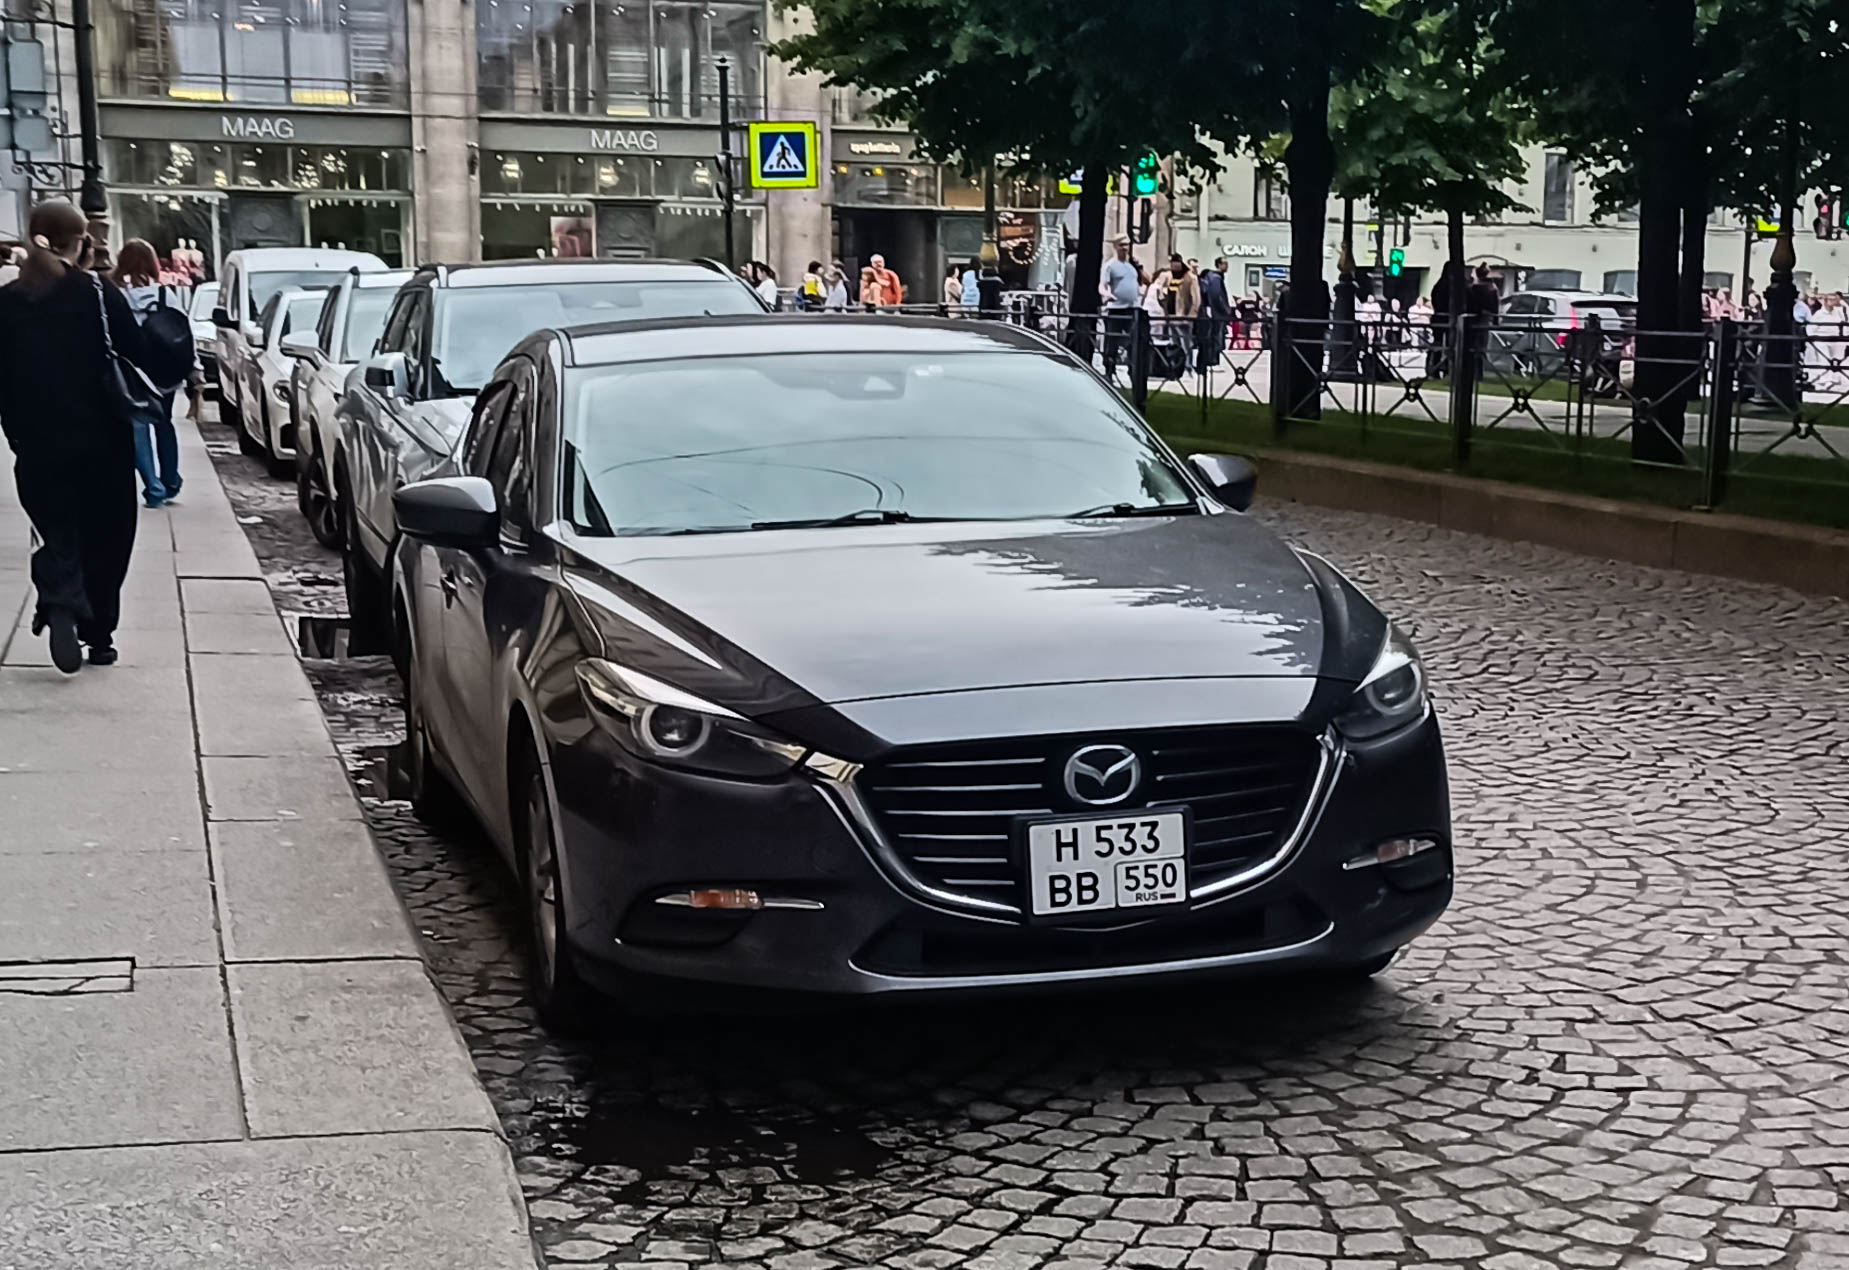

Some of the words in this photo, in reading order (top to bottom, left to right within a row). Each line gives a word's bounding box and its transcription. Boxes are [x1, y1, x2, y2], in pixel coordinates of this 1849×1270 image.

[222, 116, 294, 139] MAAG
[591, 129, 657, 150] MAAG
[1095, 821, 1160, 858] 533
[1124, 863, 1177, 891] 550
[1135, 892, 1159, 902] RUS
